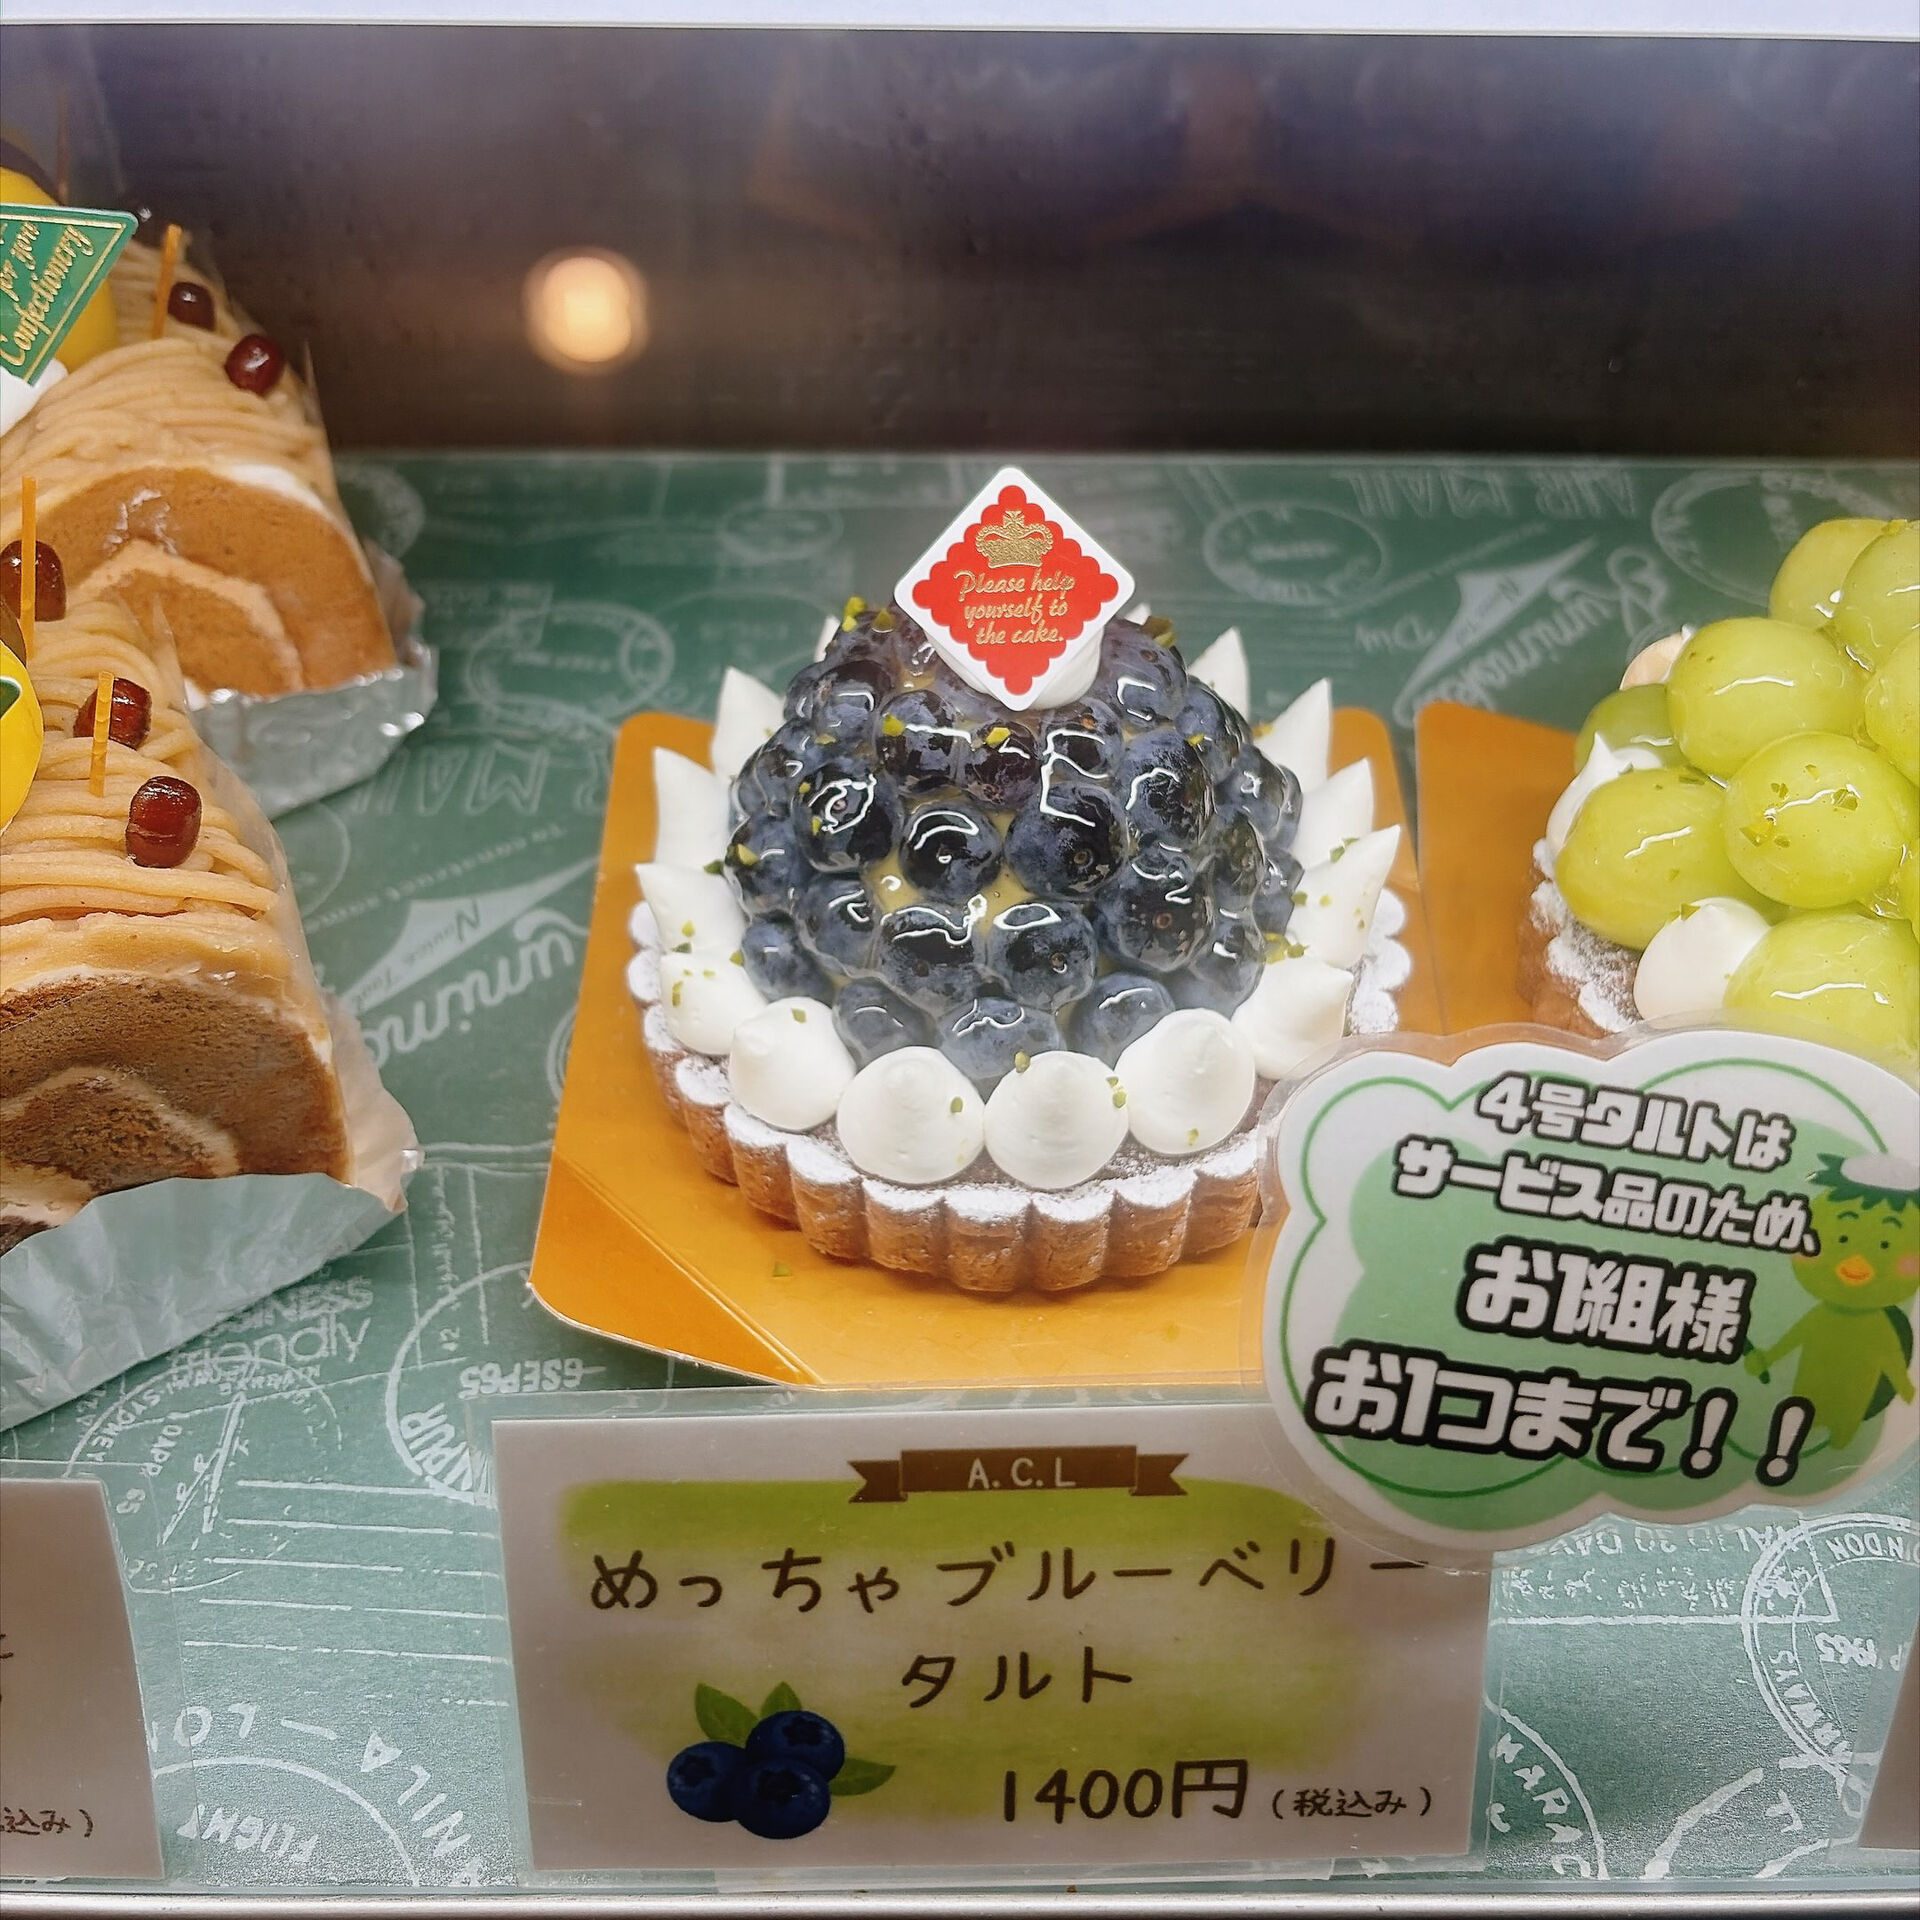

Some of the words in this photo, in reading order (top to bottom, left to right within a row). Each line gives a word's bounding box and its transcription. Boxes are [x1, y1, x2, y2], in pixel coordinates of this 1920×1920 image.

[0, 224, 95, 366] Confectionery
[953, 569, 1026, 602] Please
[1031, 567, 1076, 600] help
[963, 592, 1044, 629] yourself
[1048, 596, 1069, 617] to
[975, 621, 1008, 646] the
[1010, 621, 1064, 645] cake.
[1475, 1070, 1797, 1174] 4号タルトは
[1394, 1134, 1822, 1257] サービス品のため、
[1456, 1234, 1757, 1364] お1組様
[967, 1456, 1077, 1490] A.C.L
[590, 1536, 1430, 1614] めっちゃブルーベリー
[901, 1645, 1133, 1709] タルト
[0, 1806, 94, 1839] 込み)
[1003, 1758, 1249, 1824] 1400円
[1271, 1786, 1432, 1820] (税込み)
